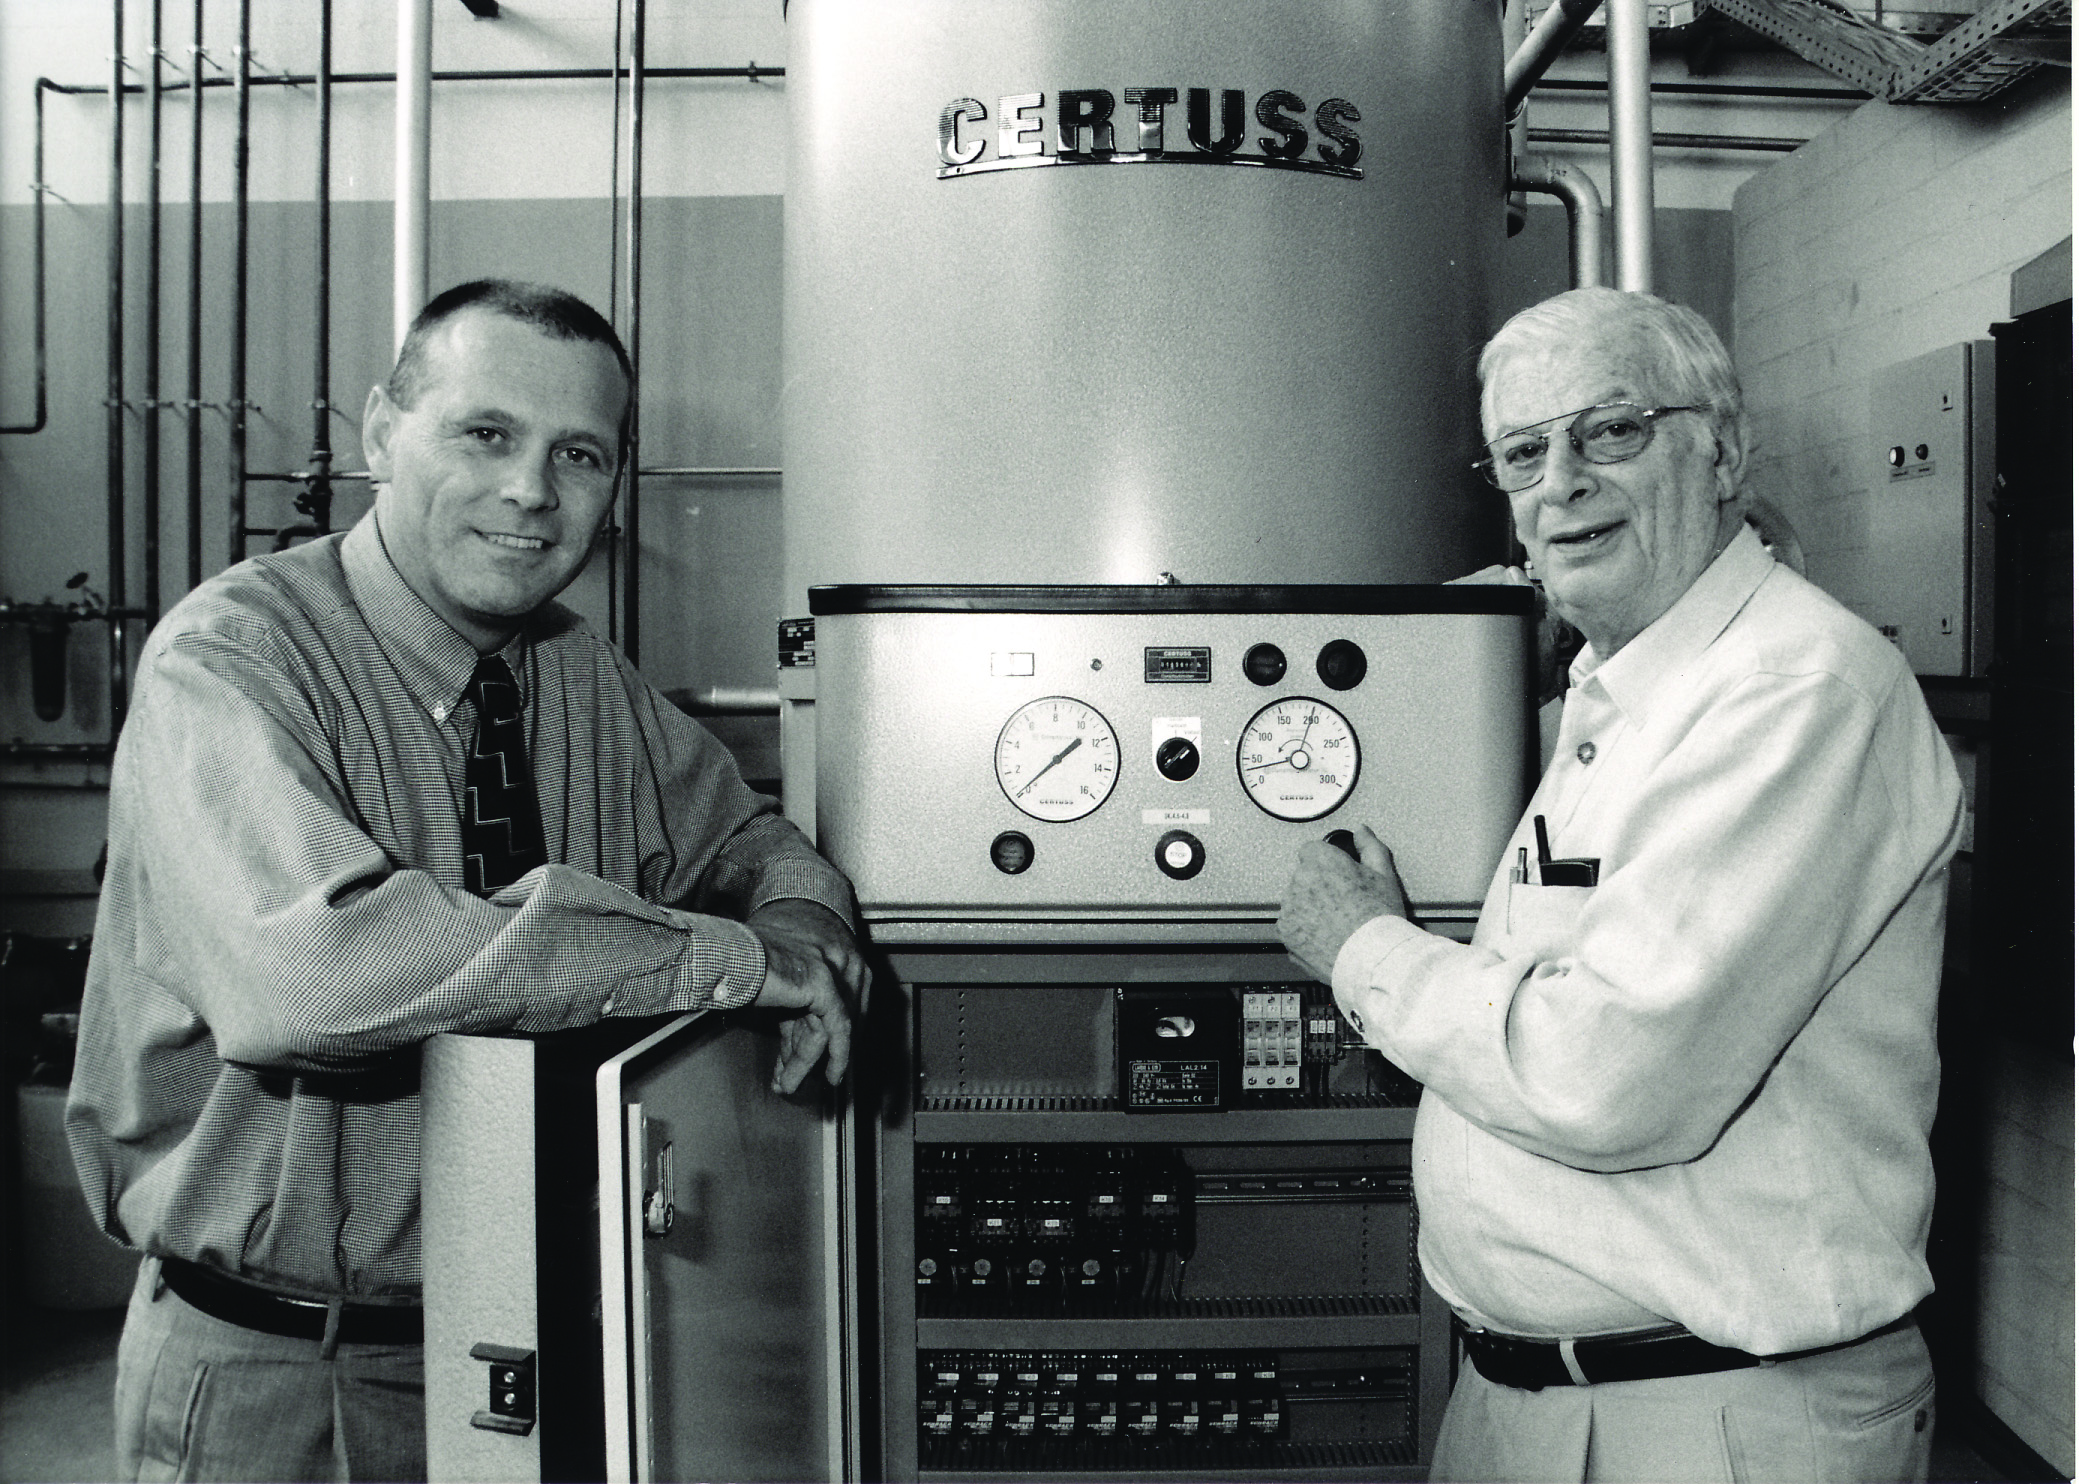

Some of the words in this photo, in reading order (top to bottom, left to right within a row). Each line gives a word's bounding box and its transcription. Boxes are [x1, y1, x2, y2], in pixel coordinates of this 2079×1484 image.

[936, 87, 1363, 166] CERTUSS
[1053, 714, 1059, 722] 8
[1277, 716, 1291, 725] 150
[1303, 716, 1319, 725] 200
[1029, 722, 1034, 730] 6
[1077, 721, 1086, 730] 10
[1258, 732, 1273, 741] 100
[1014, 741, 1020, 749] 4
[1092, 739, 1100, 748] 12
[1324, 740, 1339, 748] 250
[1252, 754, 1262, 763] 50
[1015, 765, 1021, 774] 2
[1094, 763, 1102, 773] 14
[1259, 775, 1264, 784] 0
[1320, 775, 1336, 784] 300
[1026, 785, 1031, 794] 0
[1080, 785, 1089, 795] 16
